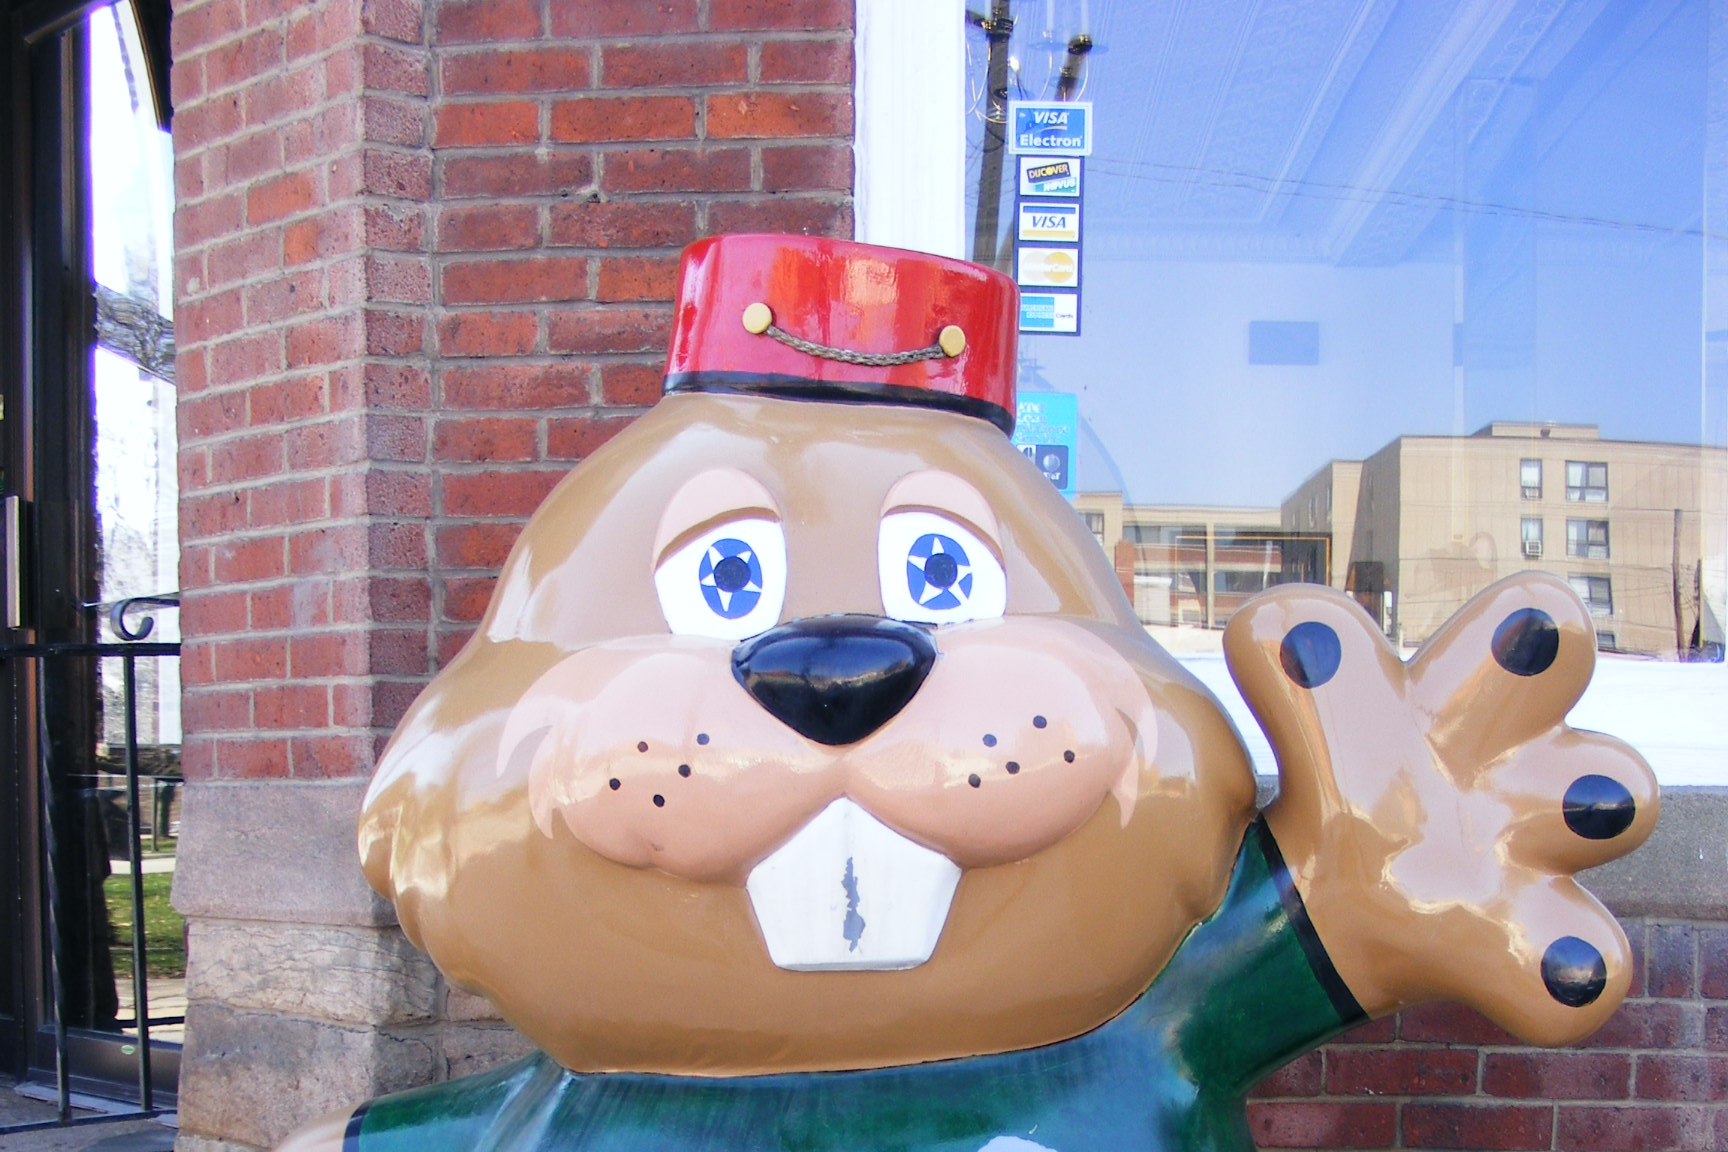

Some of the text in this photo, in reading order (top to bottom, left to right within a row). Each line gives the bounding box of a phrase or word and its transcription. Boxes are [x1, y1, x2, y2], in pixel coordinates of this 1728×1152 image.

[1033, 111, 1068, 124] VISA
[1020, 133, 1081, 147] Electron
[1028, 164, 1069, 179] DISCOVER
[1032, 215, 1066, 229] VISA
